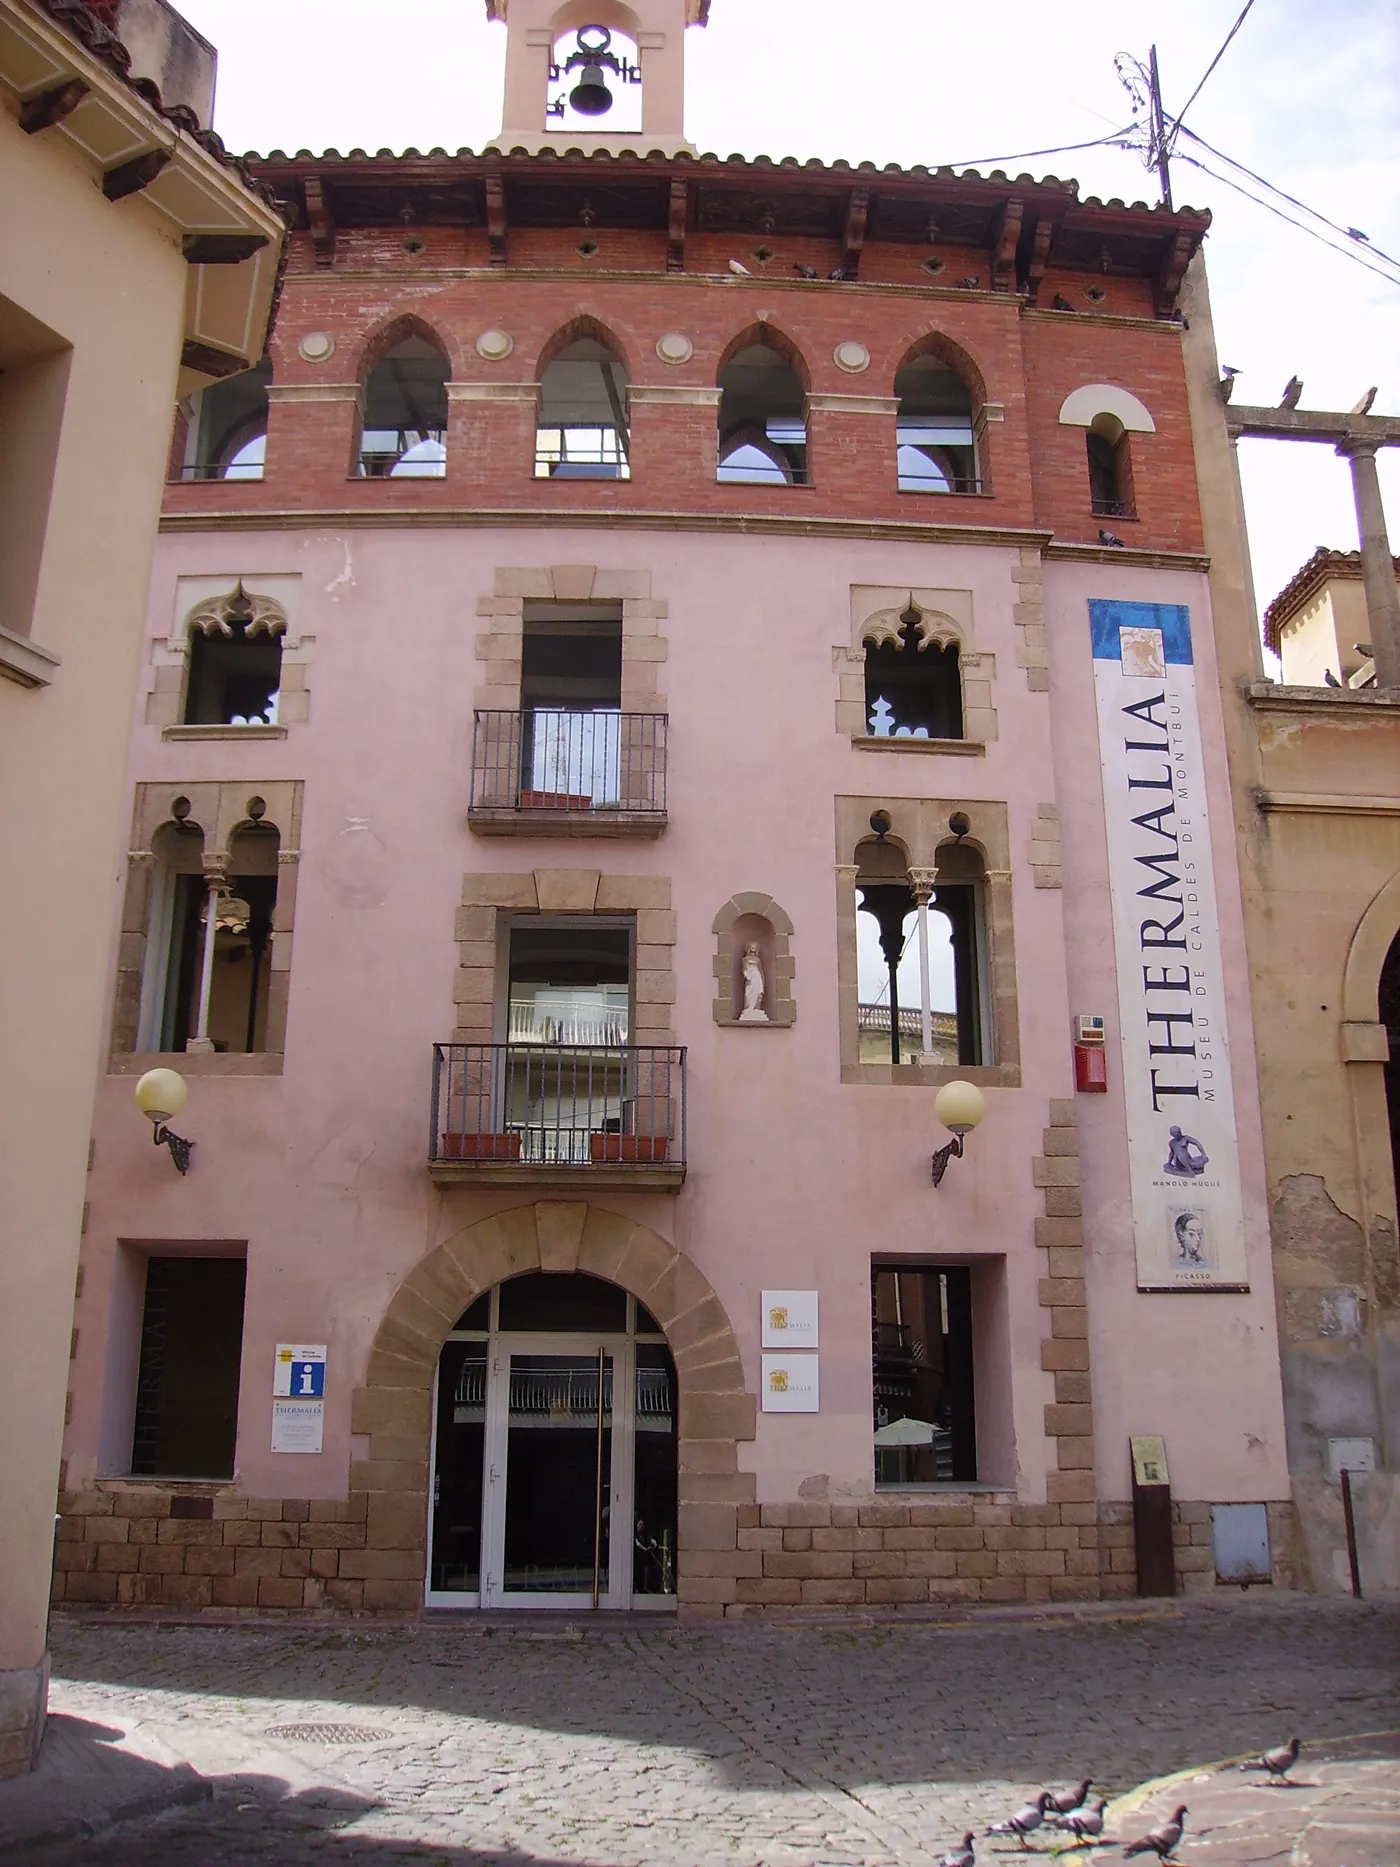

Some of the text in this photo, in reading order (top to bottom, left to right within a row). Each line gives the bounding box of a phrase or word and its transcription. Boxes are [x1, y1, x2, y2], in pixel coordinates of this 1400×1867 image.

[1180, 818, 1193, 843] DE
[1120, 688, 1201, 1113] THERMALIA
[1184, 862, 1202, 951] CALDES
[1194, 970, 1207, 996] DE
[1198, 1017, 1215, 1102] MUSEU
